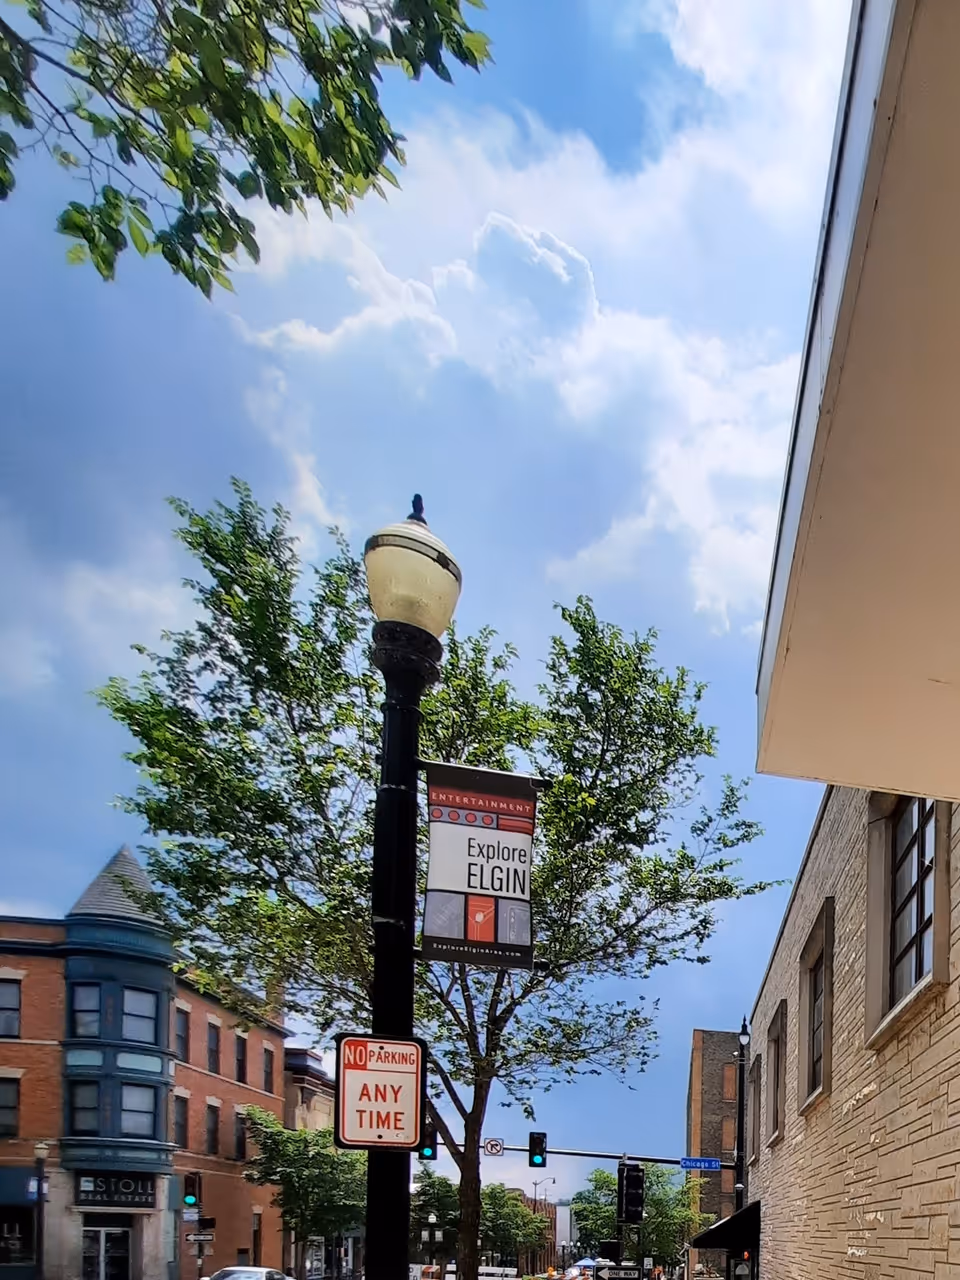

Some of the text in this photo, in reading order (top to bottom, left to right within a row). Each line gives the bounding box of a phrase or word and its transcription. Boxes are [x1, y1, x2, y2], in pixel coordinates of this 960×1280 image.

[432, 791, 531, 813] ENTERTAINMENT
[467, 837, 527, 864] Explore
[467, 863, 526, 895] ELGIN
[432, 942, 522, 957] ExploreElginArea.com
[344, 1045, 416, 1066] NO PARKING
[358, 1082, 403, 1104] ANY
[355, 1109, 405, 1131] TIME
[681, 1159, 709, 1170] Chicago
[96, 1177, 155, 1194] STOLL
